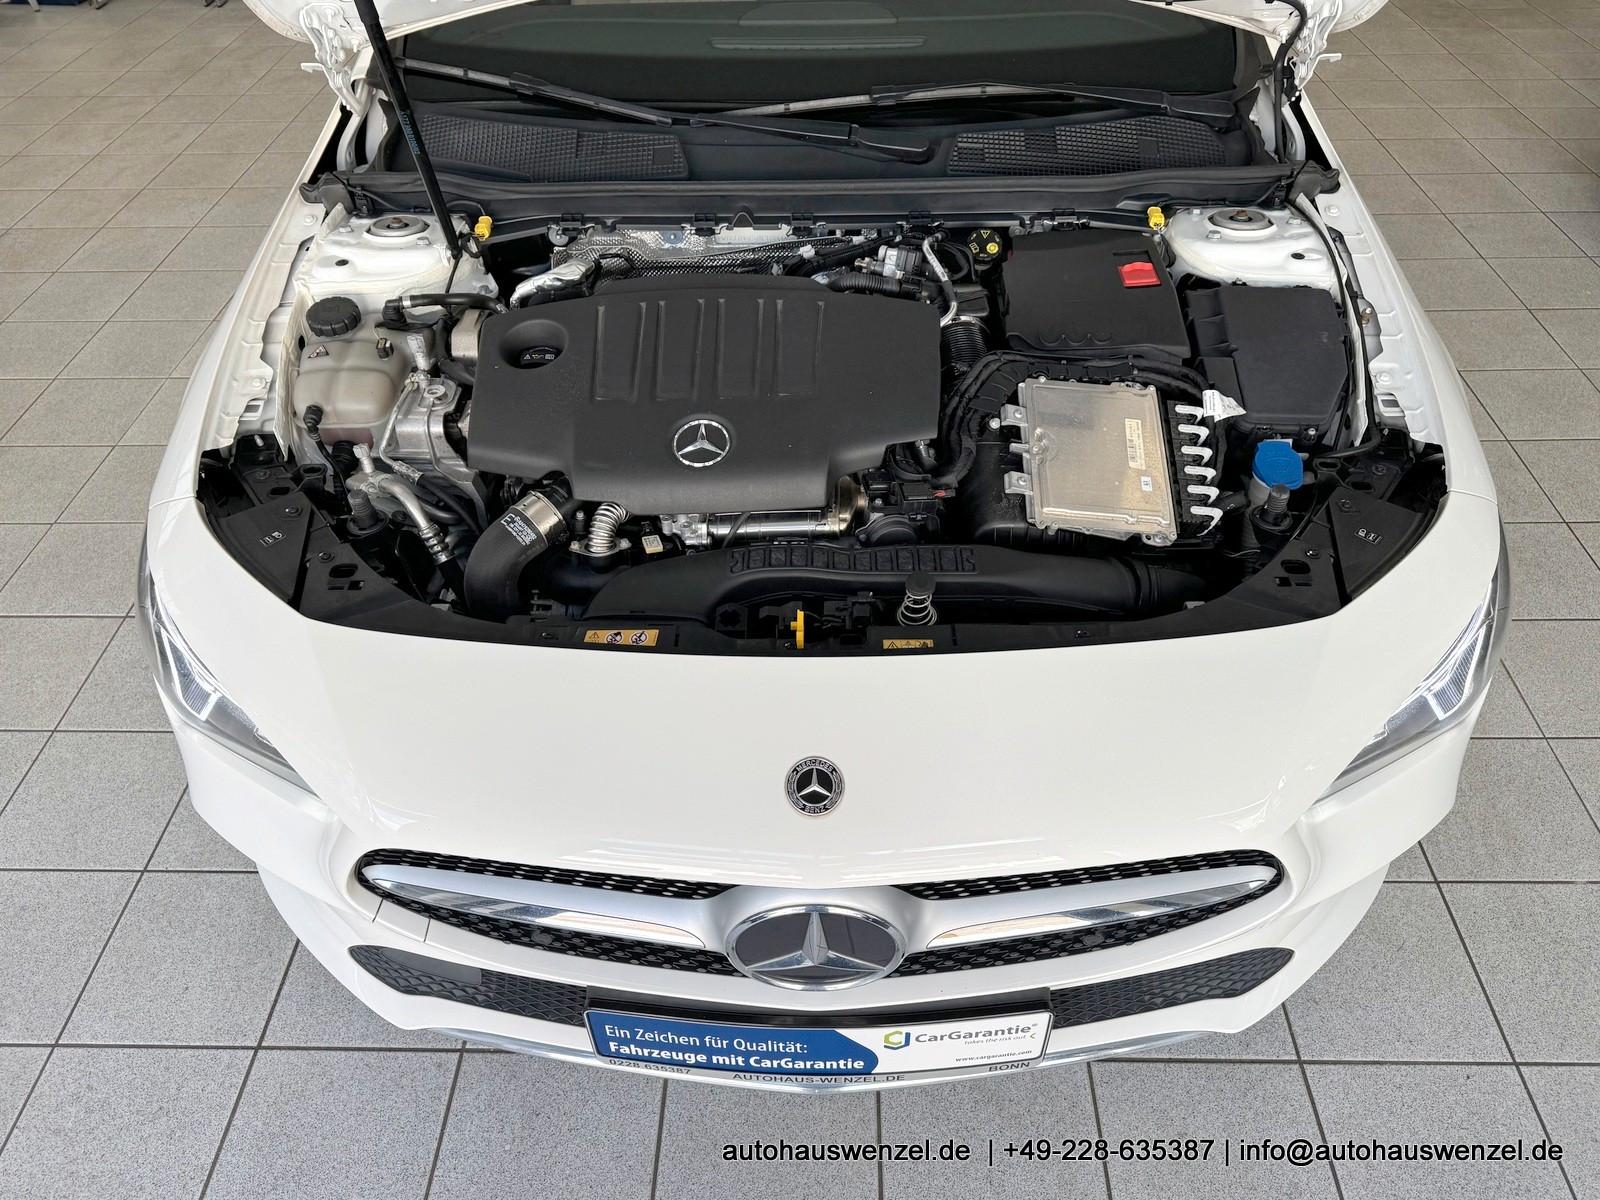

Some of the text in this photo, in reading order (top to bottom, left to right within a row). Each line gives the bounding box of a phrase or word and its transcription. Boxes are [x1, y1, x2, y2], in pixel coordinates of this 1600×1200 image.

[796, 759, 834, 771] MERCEDES
[804, 805, 825, 814] BENZ
[605, 1025, 808, 1053] Ein Zeichen für Qualität:
[609, 1041, 865, 1070] Fahrzeuge mit CarGarantie
[955, 1050, 1032, 1062] www.cargarantie.com
[609, 1059, 690, 1074] 0228 635387
[988, 1061, 1031, 1073] BONN
[733, 1073, 905, 1084] AUTOHAUS-WENZEL.DE
